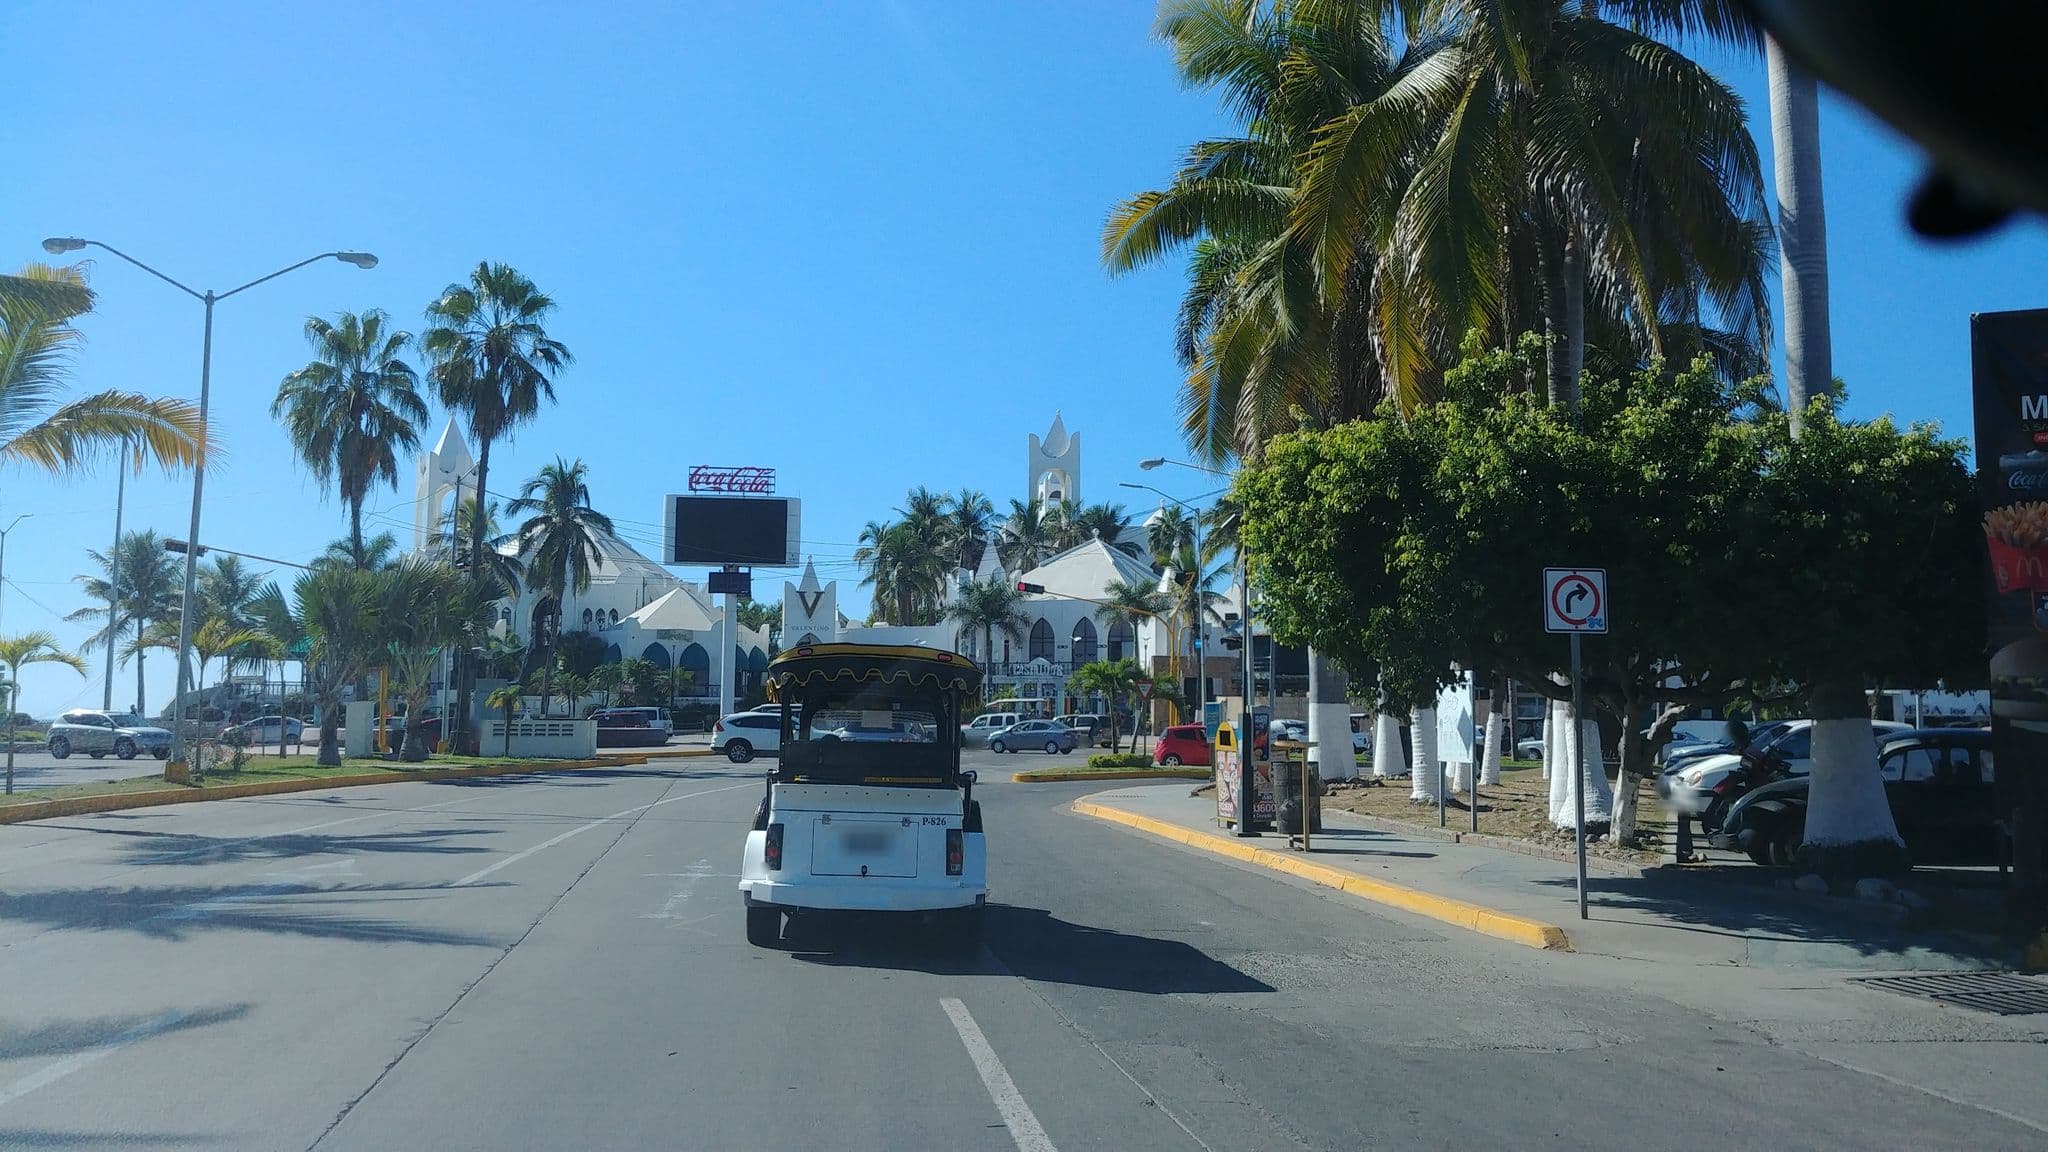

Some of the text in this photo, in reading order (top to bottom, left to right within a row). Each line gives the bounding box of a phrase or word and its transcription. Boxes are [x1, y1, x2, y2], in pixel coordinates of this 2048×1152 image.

[689, 465, 774, 492] Coca-Cola
[796, 590, 825, 619] V
[922, 817, 947, 826] P-826
